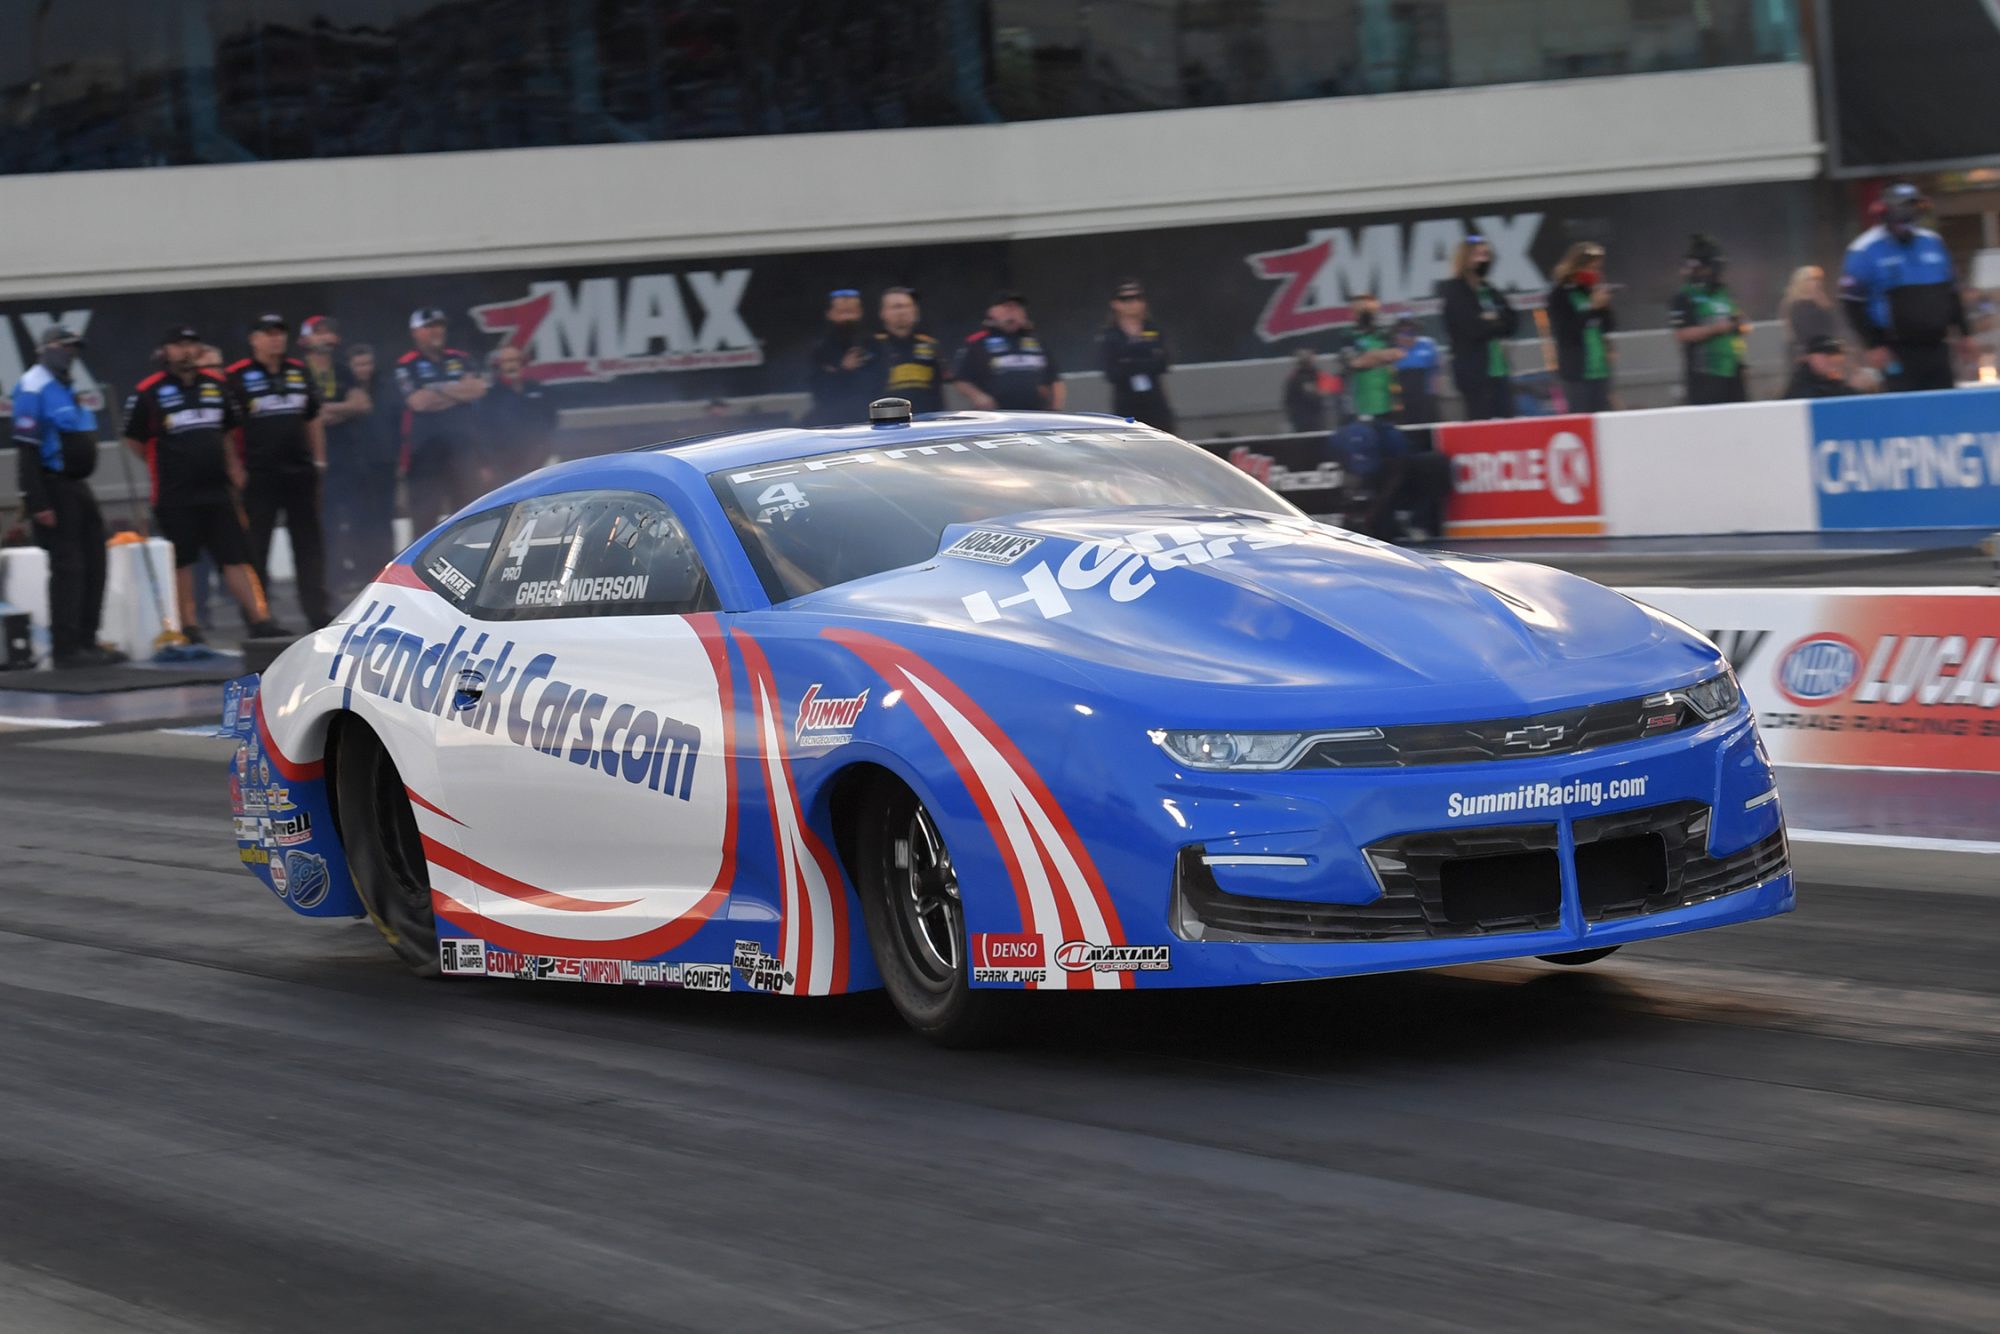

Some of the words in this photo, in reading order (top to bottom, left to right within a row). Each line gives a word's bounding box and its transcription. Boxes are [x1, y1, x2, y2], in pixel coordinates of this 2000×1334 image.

[1454, 448, 1546, 493] CIRCLE
[1815, 432, 1984, 494] CAMPING
[756, 482, 807, 506] 4
[765, 501, 810, 517] PRO
[508, 519, 537, 566] 4
[944, 531, 1037, 557] HOGAN'S
[501, 566, 522, 582] PRO
[515, 580, 558, 605] GREG
[559, 575, 649, 601] ANDERSON
[1761, 711, 1846, 732] DRAG
[1853, 714, 1970, 737] RACING
[461, 944, 480, 955] SUPER
[992, 942, 1038, 958] DENSO
[1085, 948, 1168, 960] MAXIMA
[459, 957, 483, 968] DAMPER
[487, 951, 525, 973] COMP
[583, 959, 621, 984] SIMPSON
[734, 956, 756, 968] RACE
[758, 959, 781, 971] STAR
[685, 966, 731, 988] COMETIC
[754, 971, 784, 991] PRO
[975, 969, 1009, 982] SPARK
[1012, 969, 1047, 982] PLUGS
